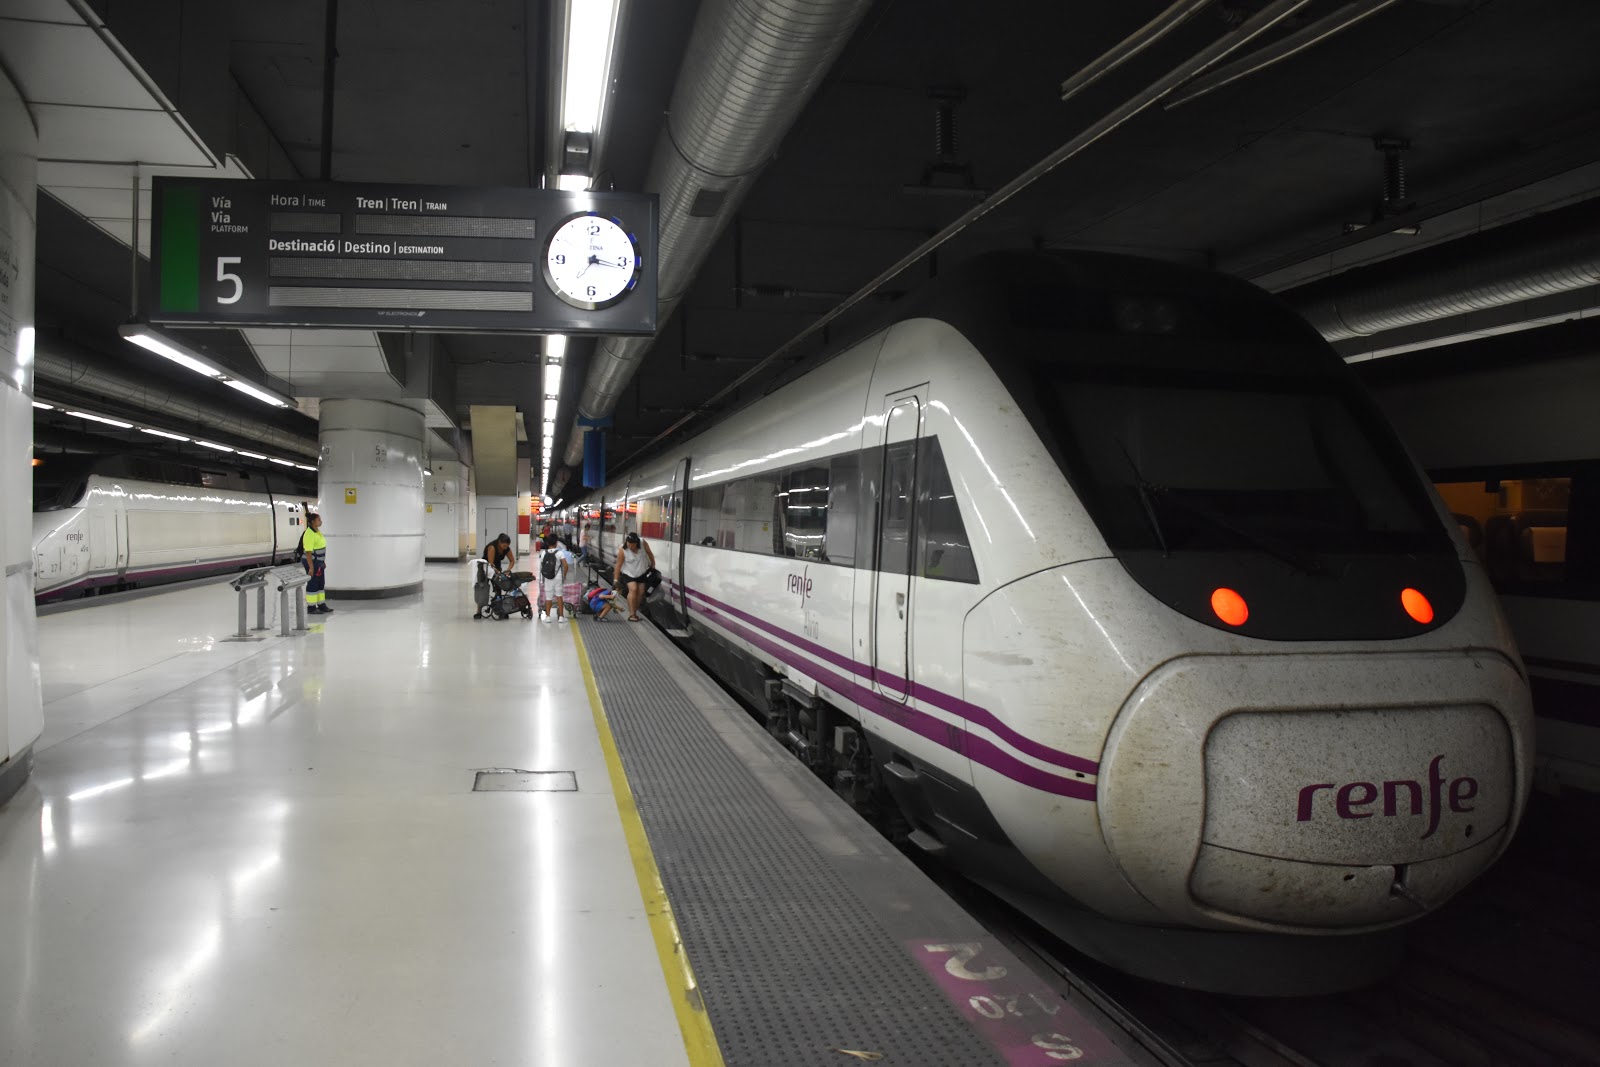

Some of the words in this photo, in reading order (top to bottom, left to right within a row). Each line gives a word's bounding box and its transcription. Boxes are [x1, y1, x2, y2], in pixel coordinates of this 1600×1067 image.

[212, 195, 232, 209] Vía
[271, 194, 299, 206] Hora
[308, 199, 326, 207] TIME
[356, 197, 383, 209] Tren
[391, 198, 417, 210] Tren
[426, 202, 447, 211] TRAIN
[211, 211, 231, 223] Via
[211, 225, 248, 233] PLATFORM
[269, 239, 335, 252] Destinació
[344, 241, 391, 254] Destino
[398, 245, 444, 254] DESTINATION
[555, 254, 566, 265] 9
[617, 256, 628, 267] 3
[216, 256, 244, 305] 5
[586, 285, 597, 296] 6
[66, 529, 84, 545] renfe
[786, 564, 813, 609] renfe
[1297, 754, 1478, 840] renfe
